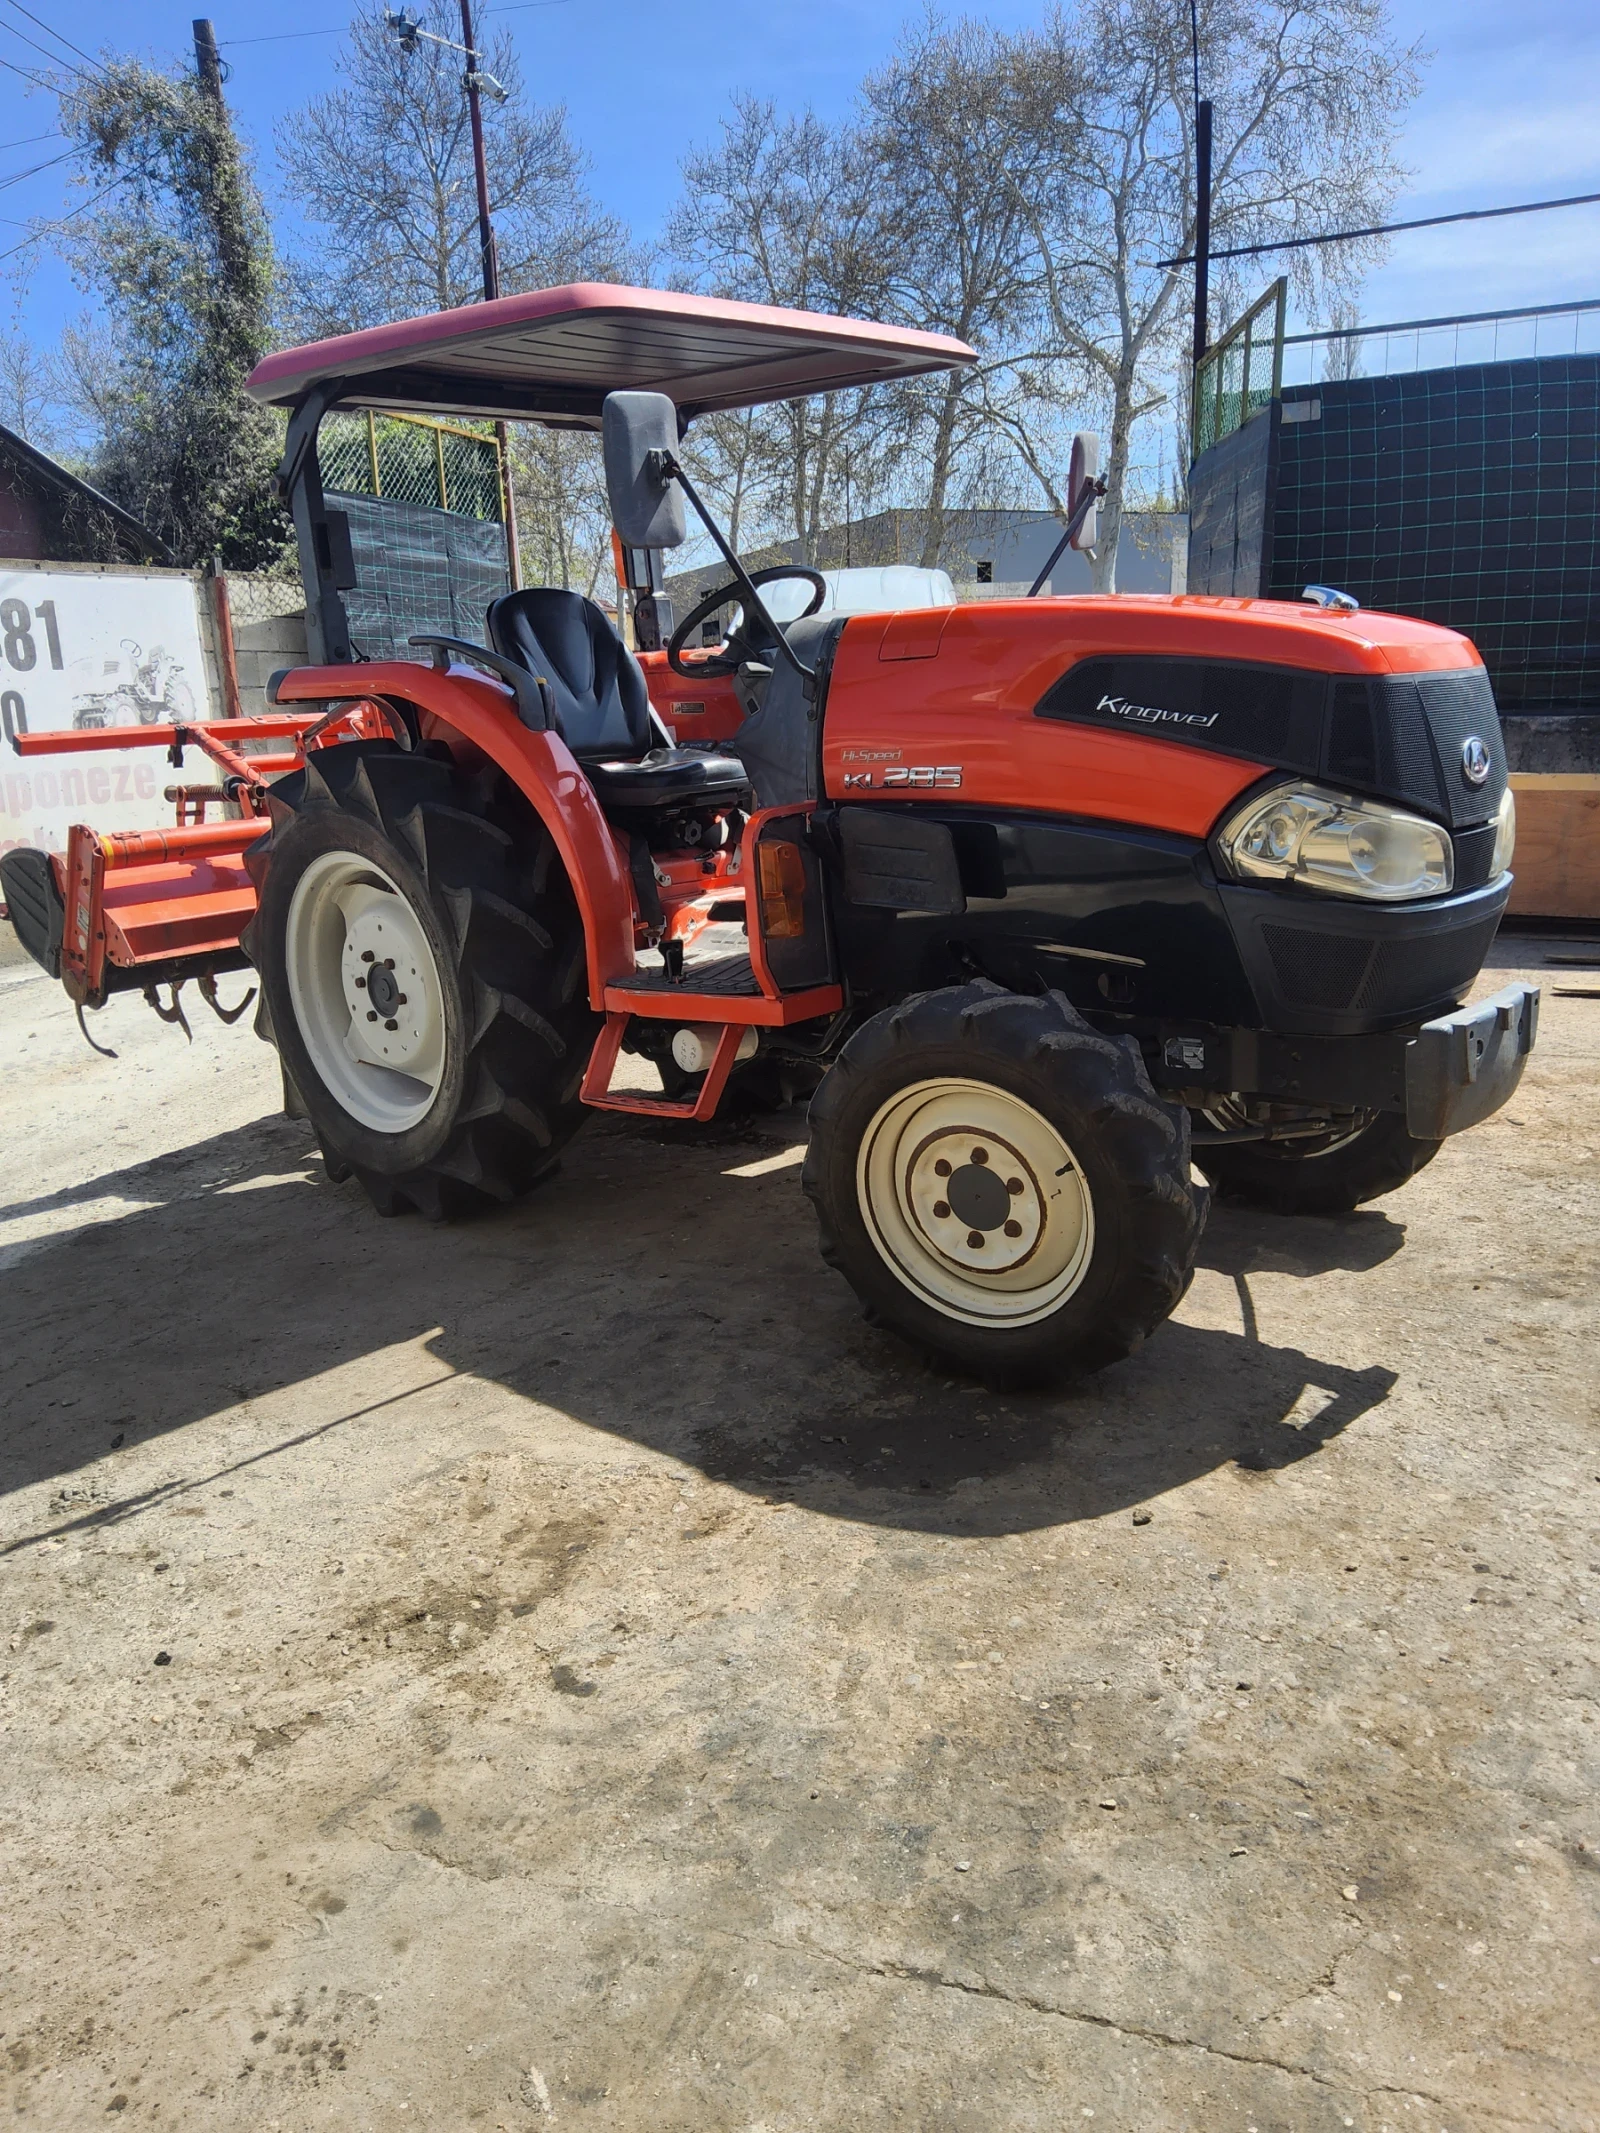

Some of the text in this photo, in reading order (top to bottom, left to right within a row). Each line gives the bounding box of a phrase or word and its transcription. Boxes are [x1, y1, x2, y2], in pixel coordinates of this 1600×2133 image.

[0, 598, 64, 671] 81
[1096, 695, 1219, 727] Kingwel
[842, 750, 902, 763] Hi-Speed
[0, 763, 157, 819] poneze
[844, 766, 963, 789] KL285
